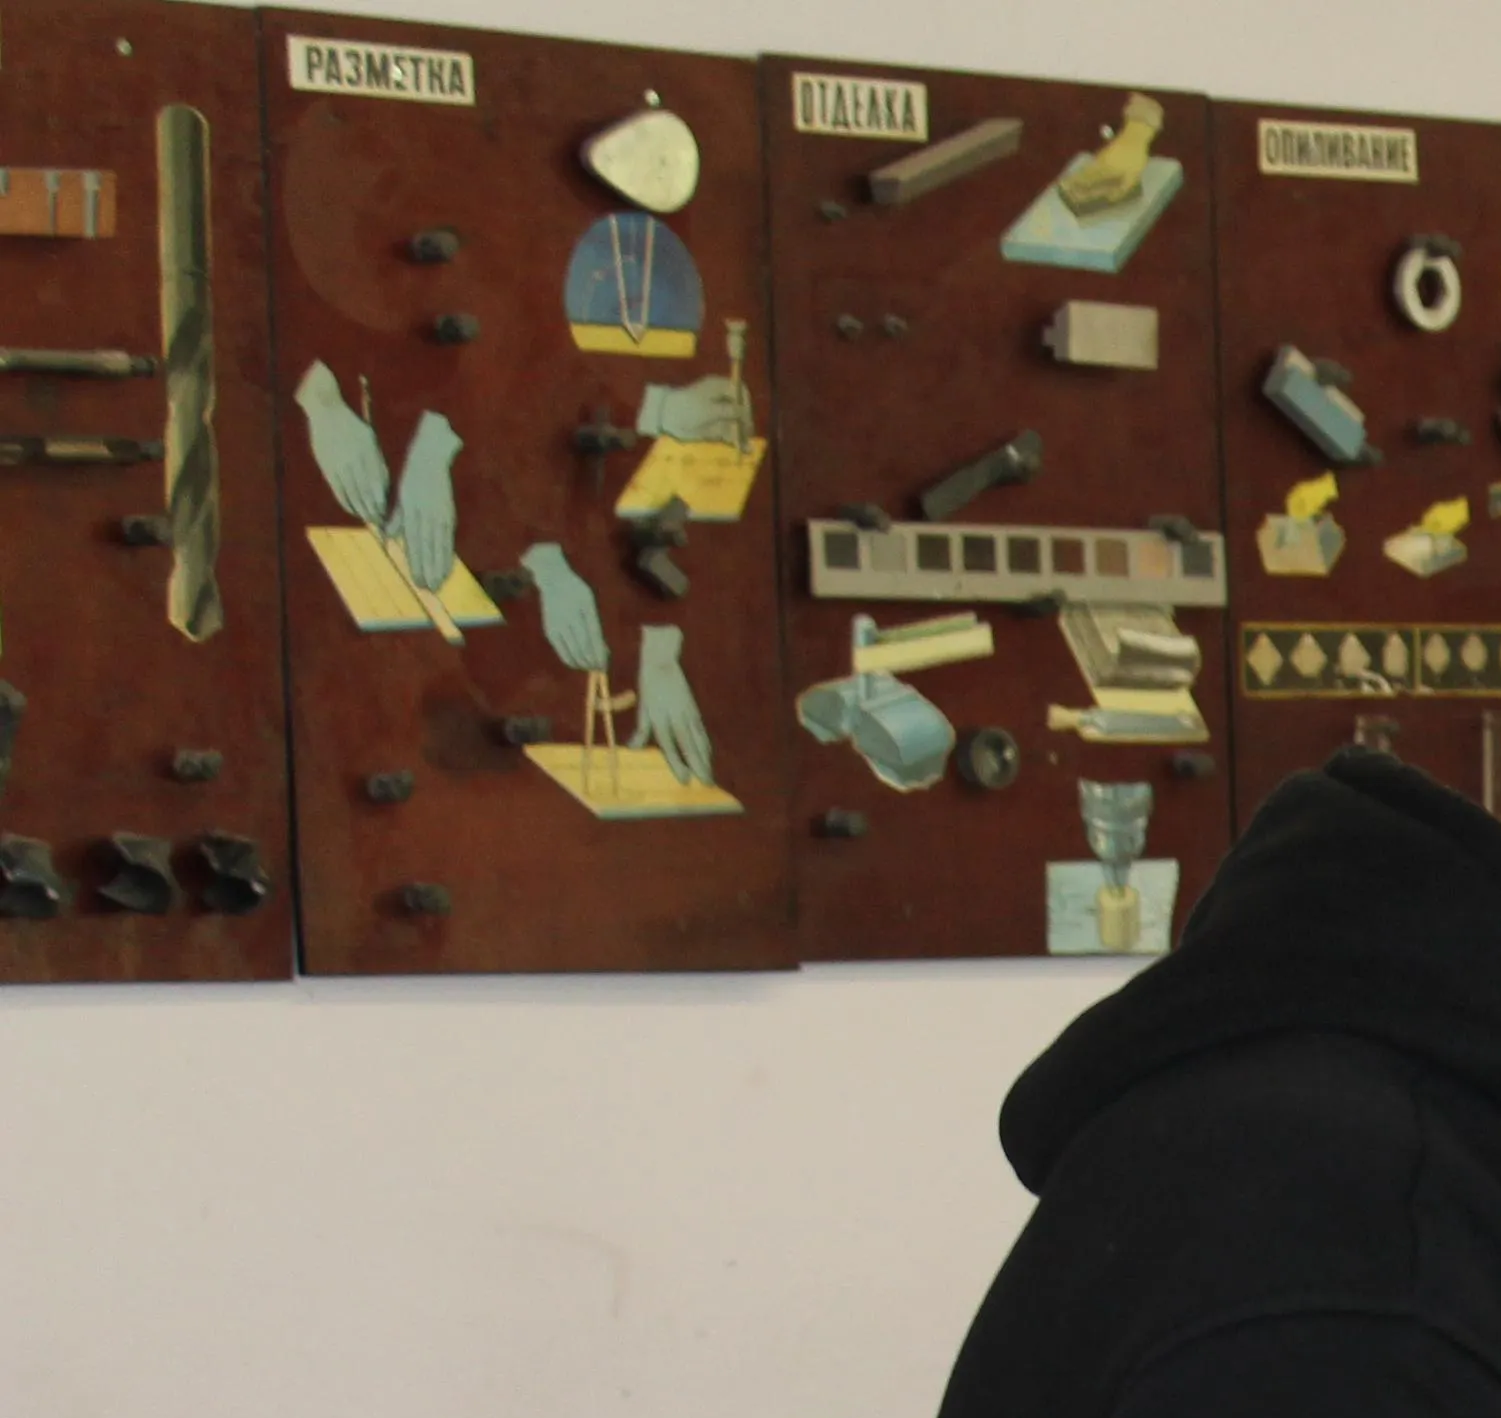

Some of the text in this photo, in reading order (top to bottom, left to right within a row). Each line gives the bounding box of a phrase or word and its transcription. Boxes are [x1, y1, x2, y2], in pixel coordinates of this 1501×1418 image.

[305, 44, 466, 95] РАЗМЕТКА
[800, 79, 917, 132] ОТДЕЛКА
[1265, 127, 1410, 173] ОПИЛИВАНИЕ
